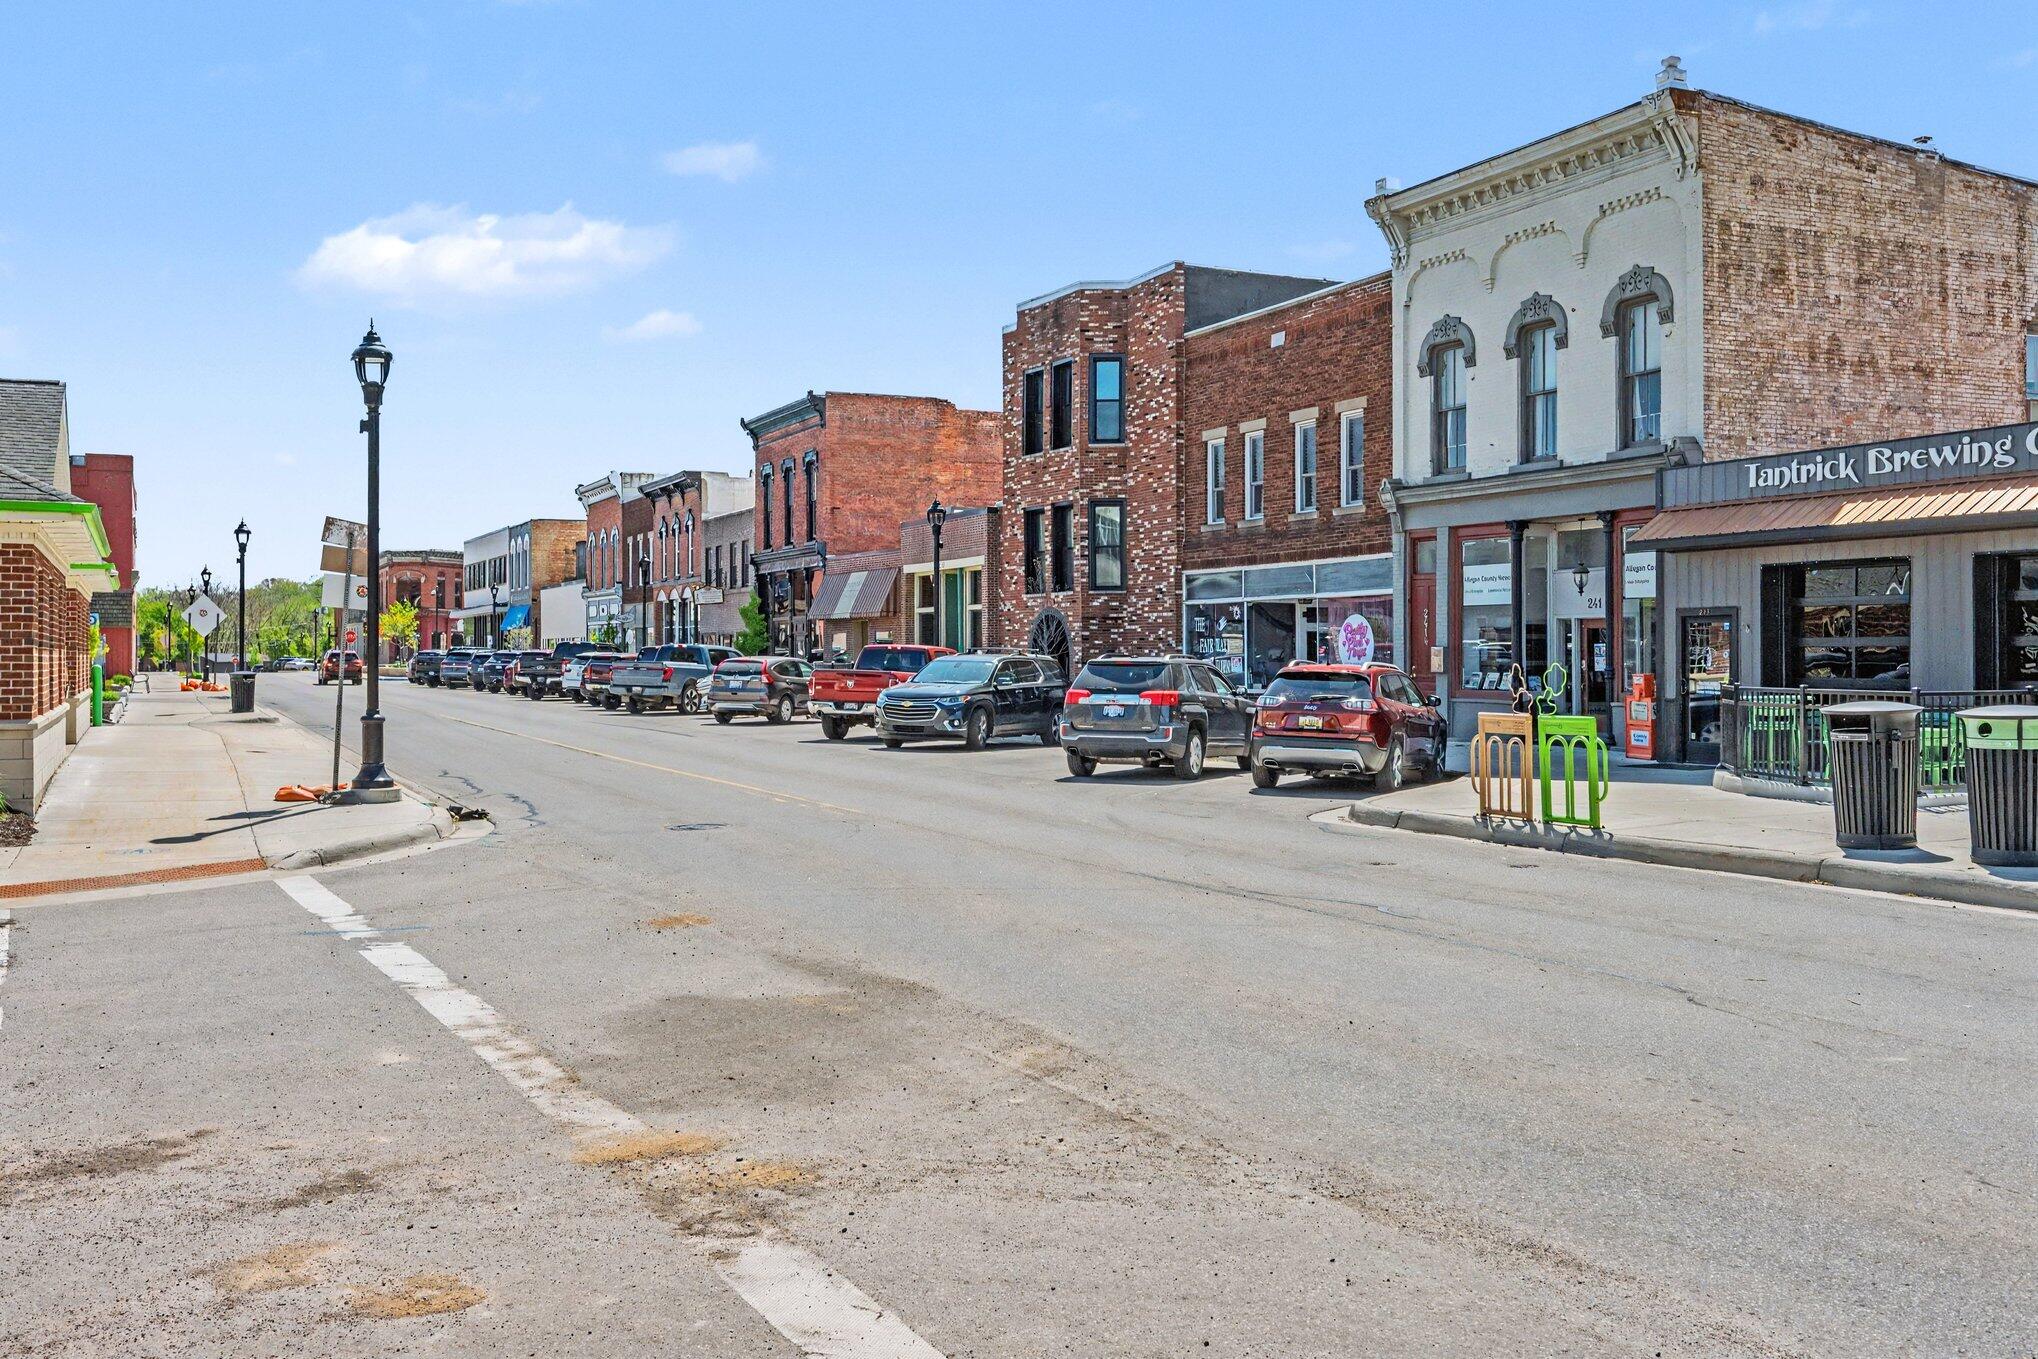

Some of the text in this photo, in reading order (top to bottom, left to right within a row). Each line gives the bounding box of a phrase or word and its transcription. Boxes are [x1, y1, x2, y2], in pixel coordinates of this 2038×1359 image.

[1745, 453, 1860, 488] Tantrick
[1868, 434, 2016, 475] Brewing
[1587, 597, 1602, 608] 241
[1194, 617, 1206, 632] THE
[1200, 638, 1214, 653] FAIR
